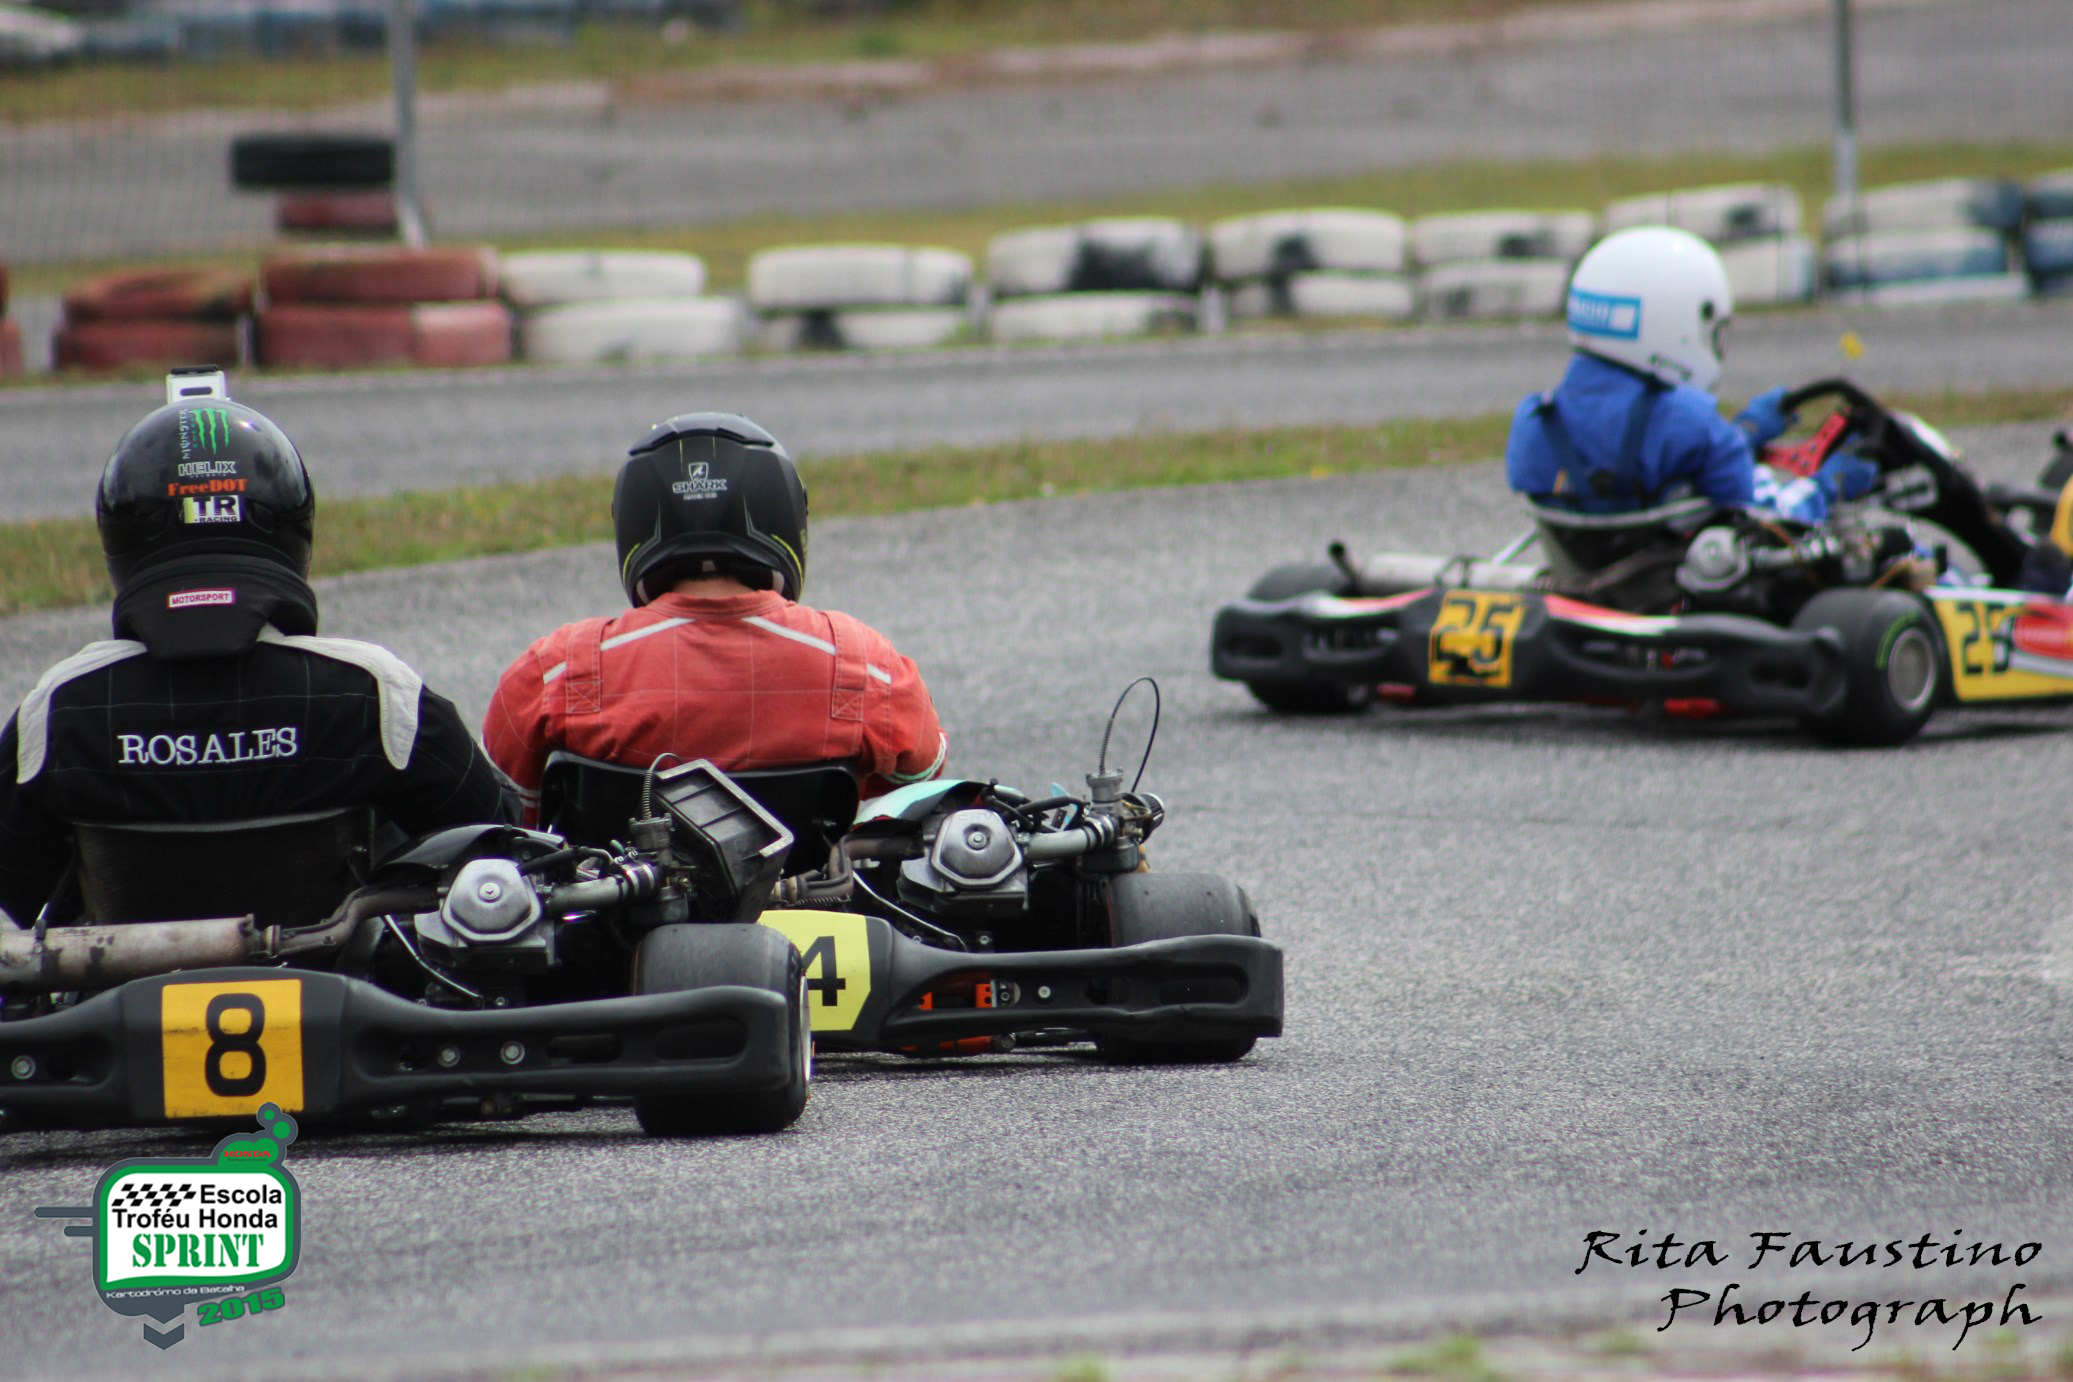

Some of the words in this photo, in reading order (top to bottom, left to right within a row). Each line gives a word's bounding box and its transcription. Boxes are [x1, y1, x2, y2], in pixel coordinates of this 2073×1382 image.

[178, 461, 236, 477] HELIX
[672, 478, 728, 494] SHARK
[193, 496, 237, 516] TR
[172, 592, 230, 605] MOTORSPORT
[1434, 598, 1514, 666] 25
[1957, 602, 2014, 674] 25
[117, 727, 298, 766] ROSALES
[801, 935, 847, 1007] 4
[205, 993, 267, 1097] 8
